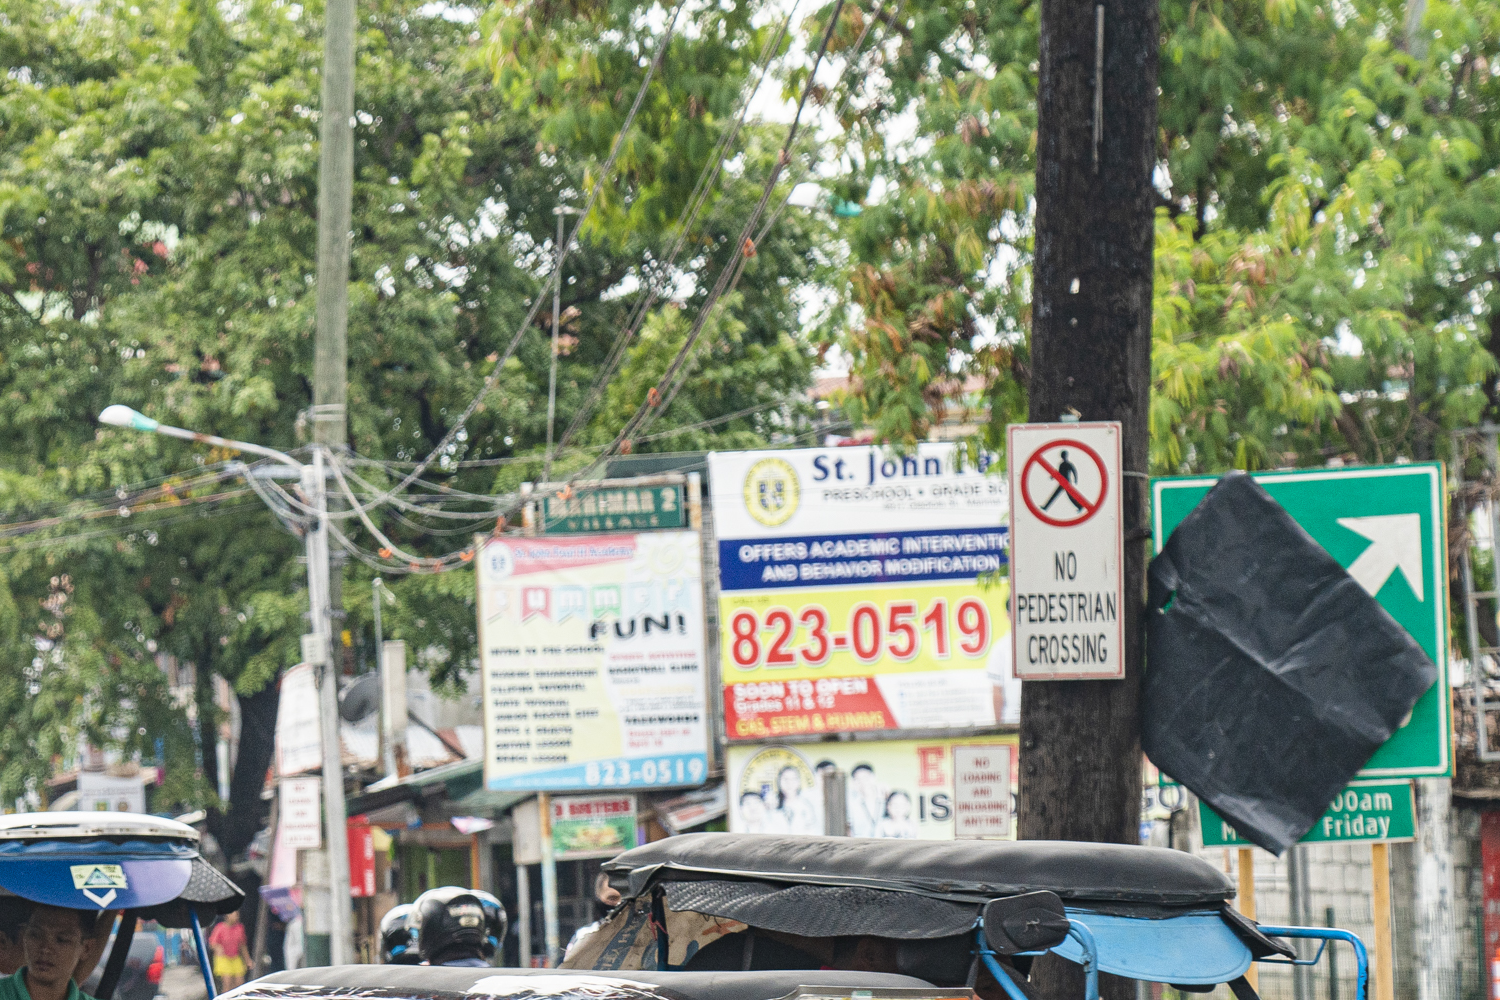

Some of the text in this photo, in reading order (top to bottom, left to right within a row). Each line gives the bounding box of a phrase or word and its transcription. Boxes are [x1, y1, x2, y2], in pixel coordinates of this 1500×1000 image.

[813, 454, 854, 481] St.
[868, 451, 941, 484] John
[660, 487, 677, 512] 2
[823, 485, 913, 501] PRESCHOOL
[932, 482, 981, 496] GRADE
[739, 541, 808, 562] OFFERS
[809, 537, 900, 558] ACADEMIC
[761, 554, 1000, 582] AND BEHAVIOR MODIFICATION
[1054, 550, 1077, 581] NO
[1017, 591, 1117, 625] PEDESTRIAN
[589, 614, 687, 640] FUN!
[732, 600, 989, 667] 823-0519
[1028, 633, 1108, 664] CROSSING
[733, 677, 869, 700] SOON TO OPEN
[734, 697, 784, 714] Grades
[585, 757, 704, 786] 823-0519
[974, 757, 990, 767] NO
[963, 774, 1002, 783] LOADING
[918, 793, 953, 823] IS
[958, 802, 1008, 812] UNLOADING
[1323, 813, 1391, 839] Friday
